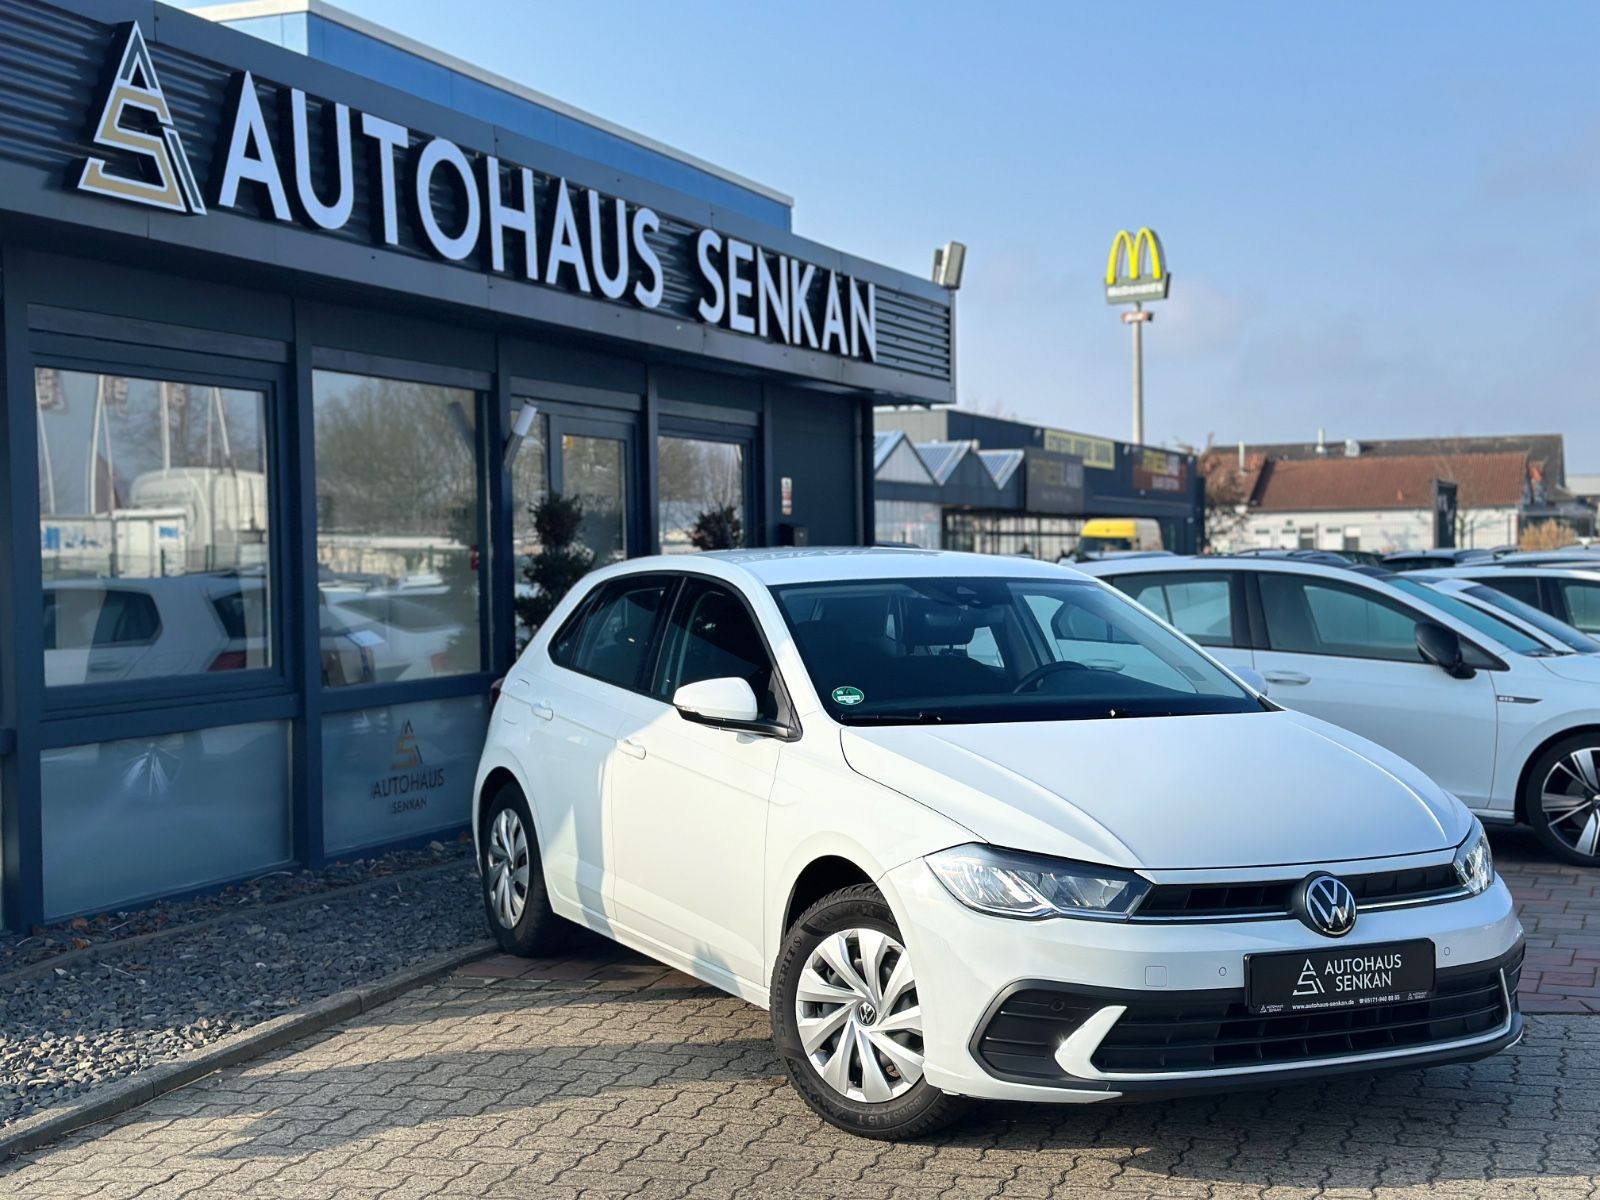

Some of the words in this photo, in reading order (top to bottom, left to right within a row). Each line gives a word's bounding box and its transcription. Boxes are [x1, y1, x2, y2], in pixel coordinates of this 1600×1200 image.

[218, 70, 665, 309] AUTOHAUS
[697, 228, 878, 363] SENKAN
[372, 768, 445, 800] AUTOHAUS
[391, 797, 427, 814] SENKAN
[1324, 953, 1402, 975] AUTOHAUS
[775, 945, 796, 1037] SEMPERIT
[1335, 971, 1392, 992] SENKAN
[1292, 999, 1355, 1010] www.autohaus-senkan.de
